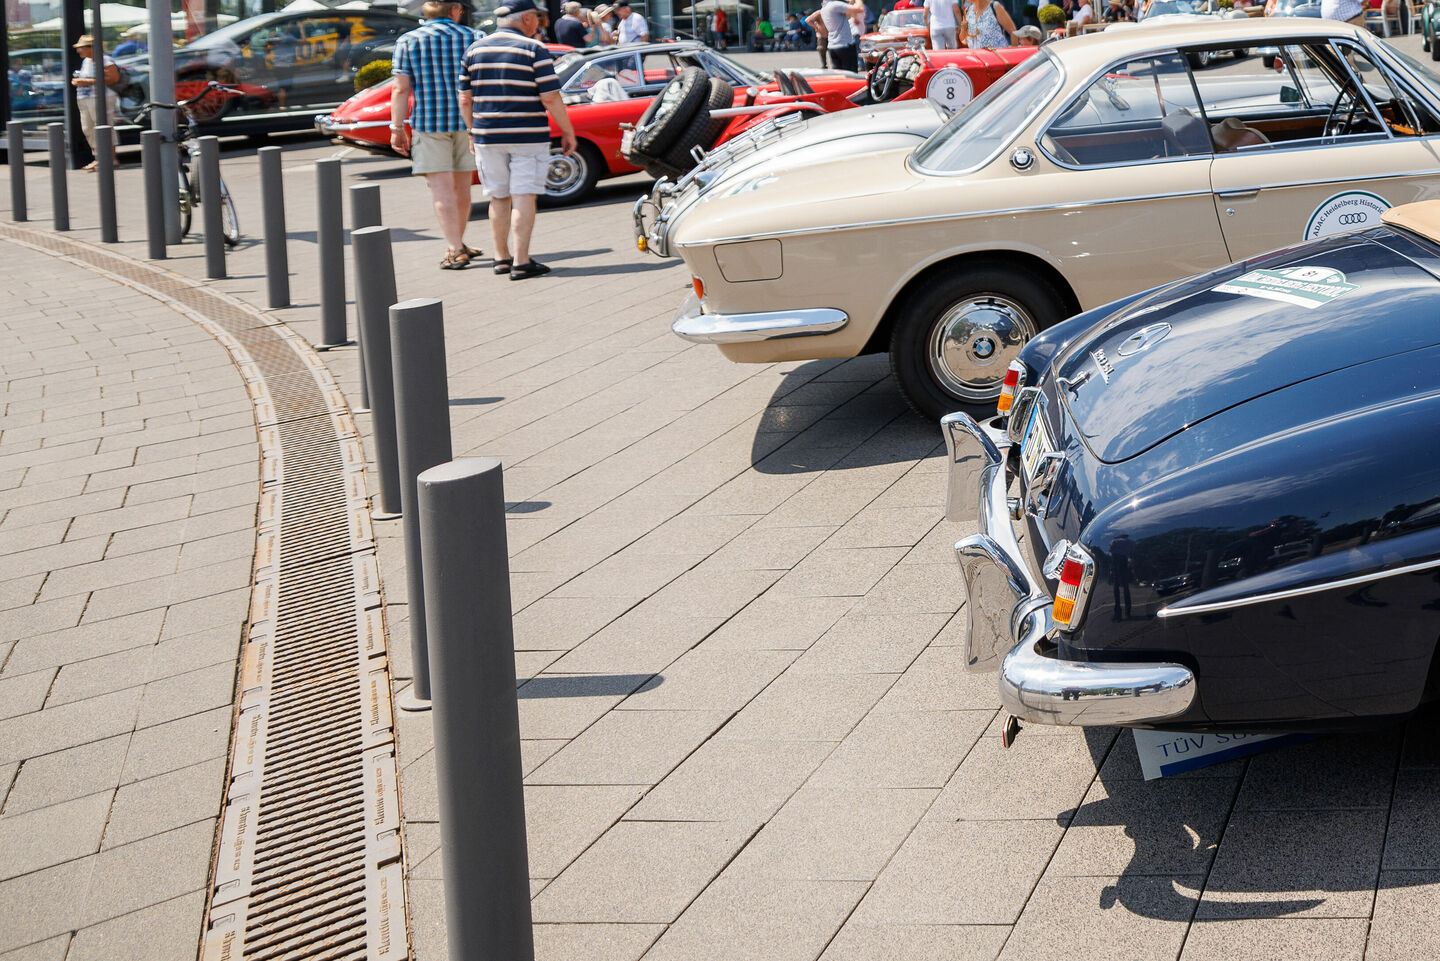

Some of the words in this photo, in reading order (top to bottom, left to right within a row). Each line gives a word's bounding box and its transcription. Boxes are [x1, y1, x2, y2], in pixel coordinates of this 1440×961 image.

[946, 86, 955, 100] 8
[1312, 216, 1326, 237] ADAC
[1324, 199, 1358, 217] Heidelberg
[1359, 198, 1384, 214] Historic
[1155, 735, 1205, 758] TÜV
